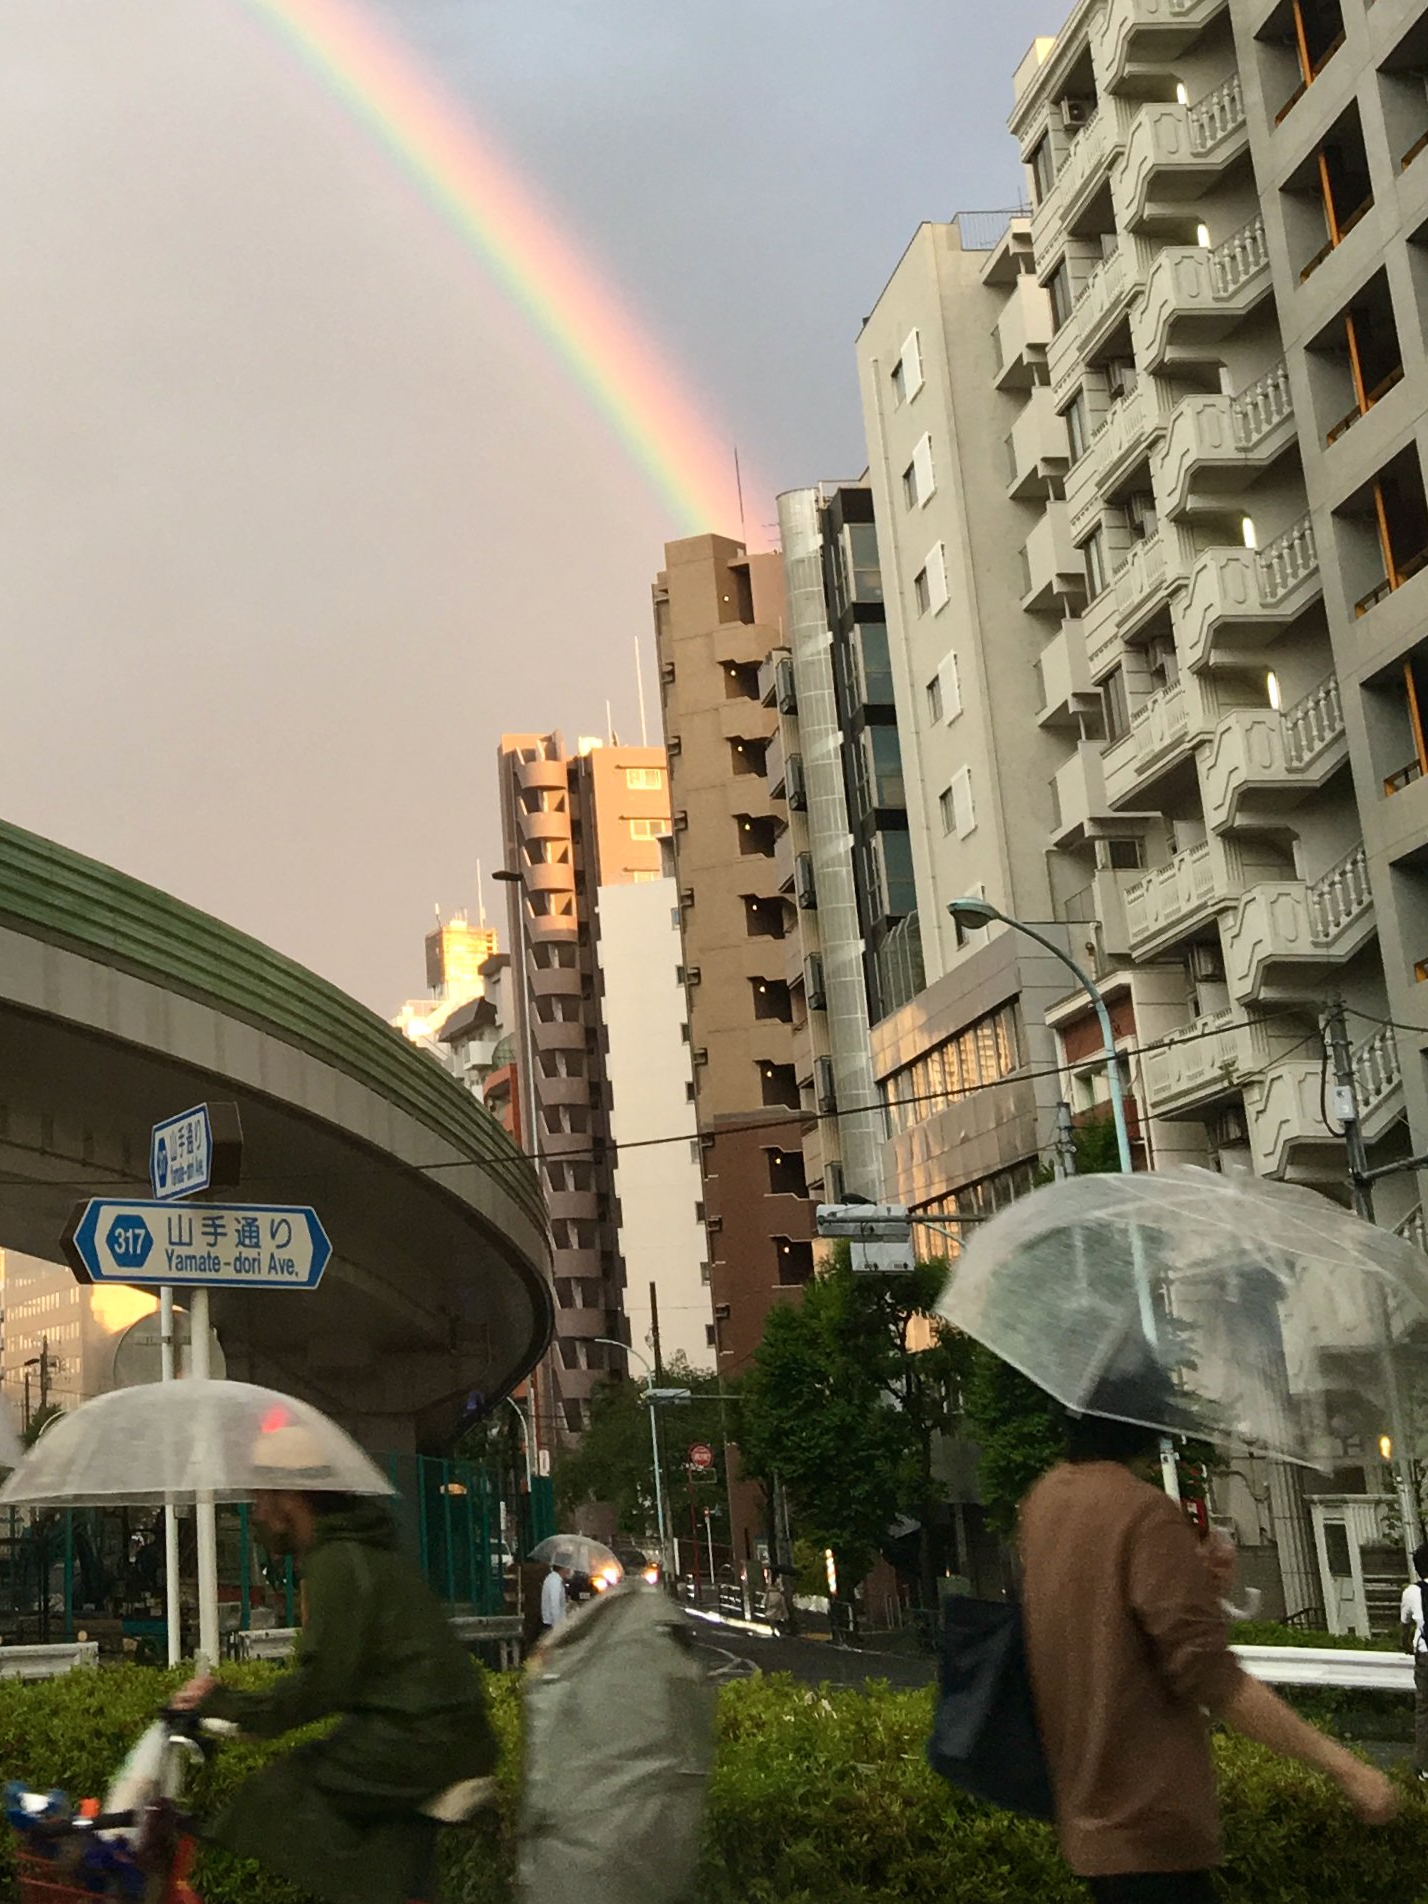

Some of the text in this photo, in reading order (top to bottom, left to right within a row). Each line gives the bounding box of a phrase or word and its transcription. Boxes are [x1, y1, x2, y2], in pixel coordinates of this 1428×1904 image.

[114, 1228, 146, 1255] 317
[167, 1213, 293, 1251] 山手通り
[165, 1248, 299, 1278] Yamate-dori Ave.
